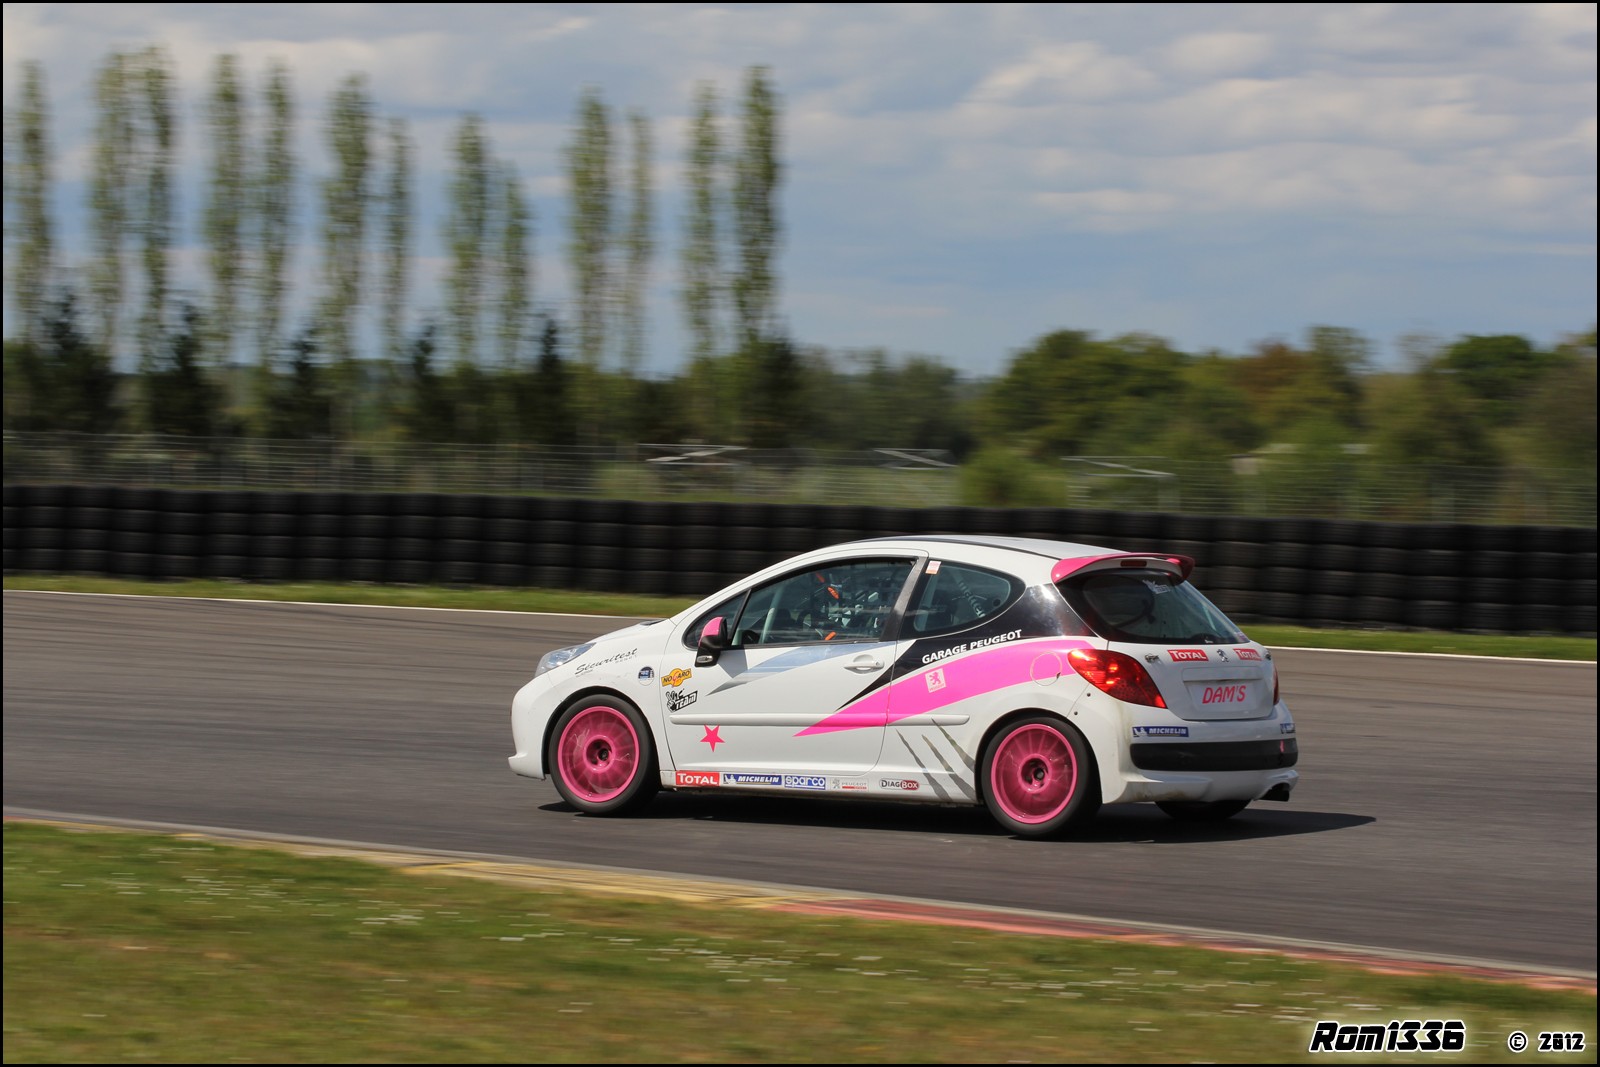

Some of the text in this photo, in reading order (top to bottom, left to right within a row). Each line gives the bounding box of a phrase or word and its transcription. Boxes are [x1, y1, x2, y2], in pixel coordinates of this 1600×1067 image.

[922, 629, 1022, 664] GARAGE PEUGEOT
[1173, 650, 1207, 660] TOTAL
[1236, 649, 1262, 660] TOTAL
[662, 670, 691, 687] NOGARO
[1202, 685, 1247, 704] DAM'S
[1148, 726, 1187, 735] MICHELIN
[677, 772, 718, 785] TOTAL
[737, 774, 780, 783] MICHELIN
[785, 775, 826, 787] sparco
